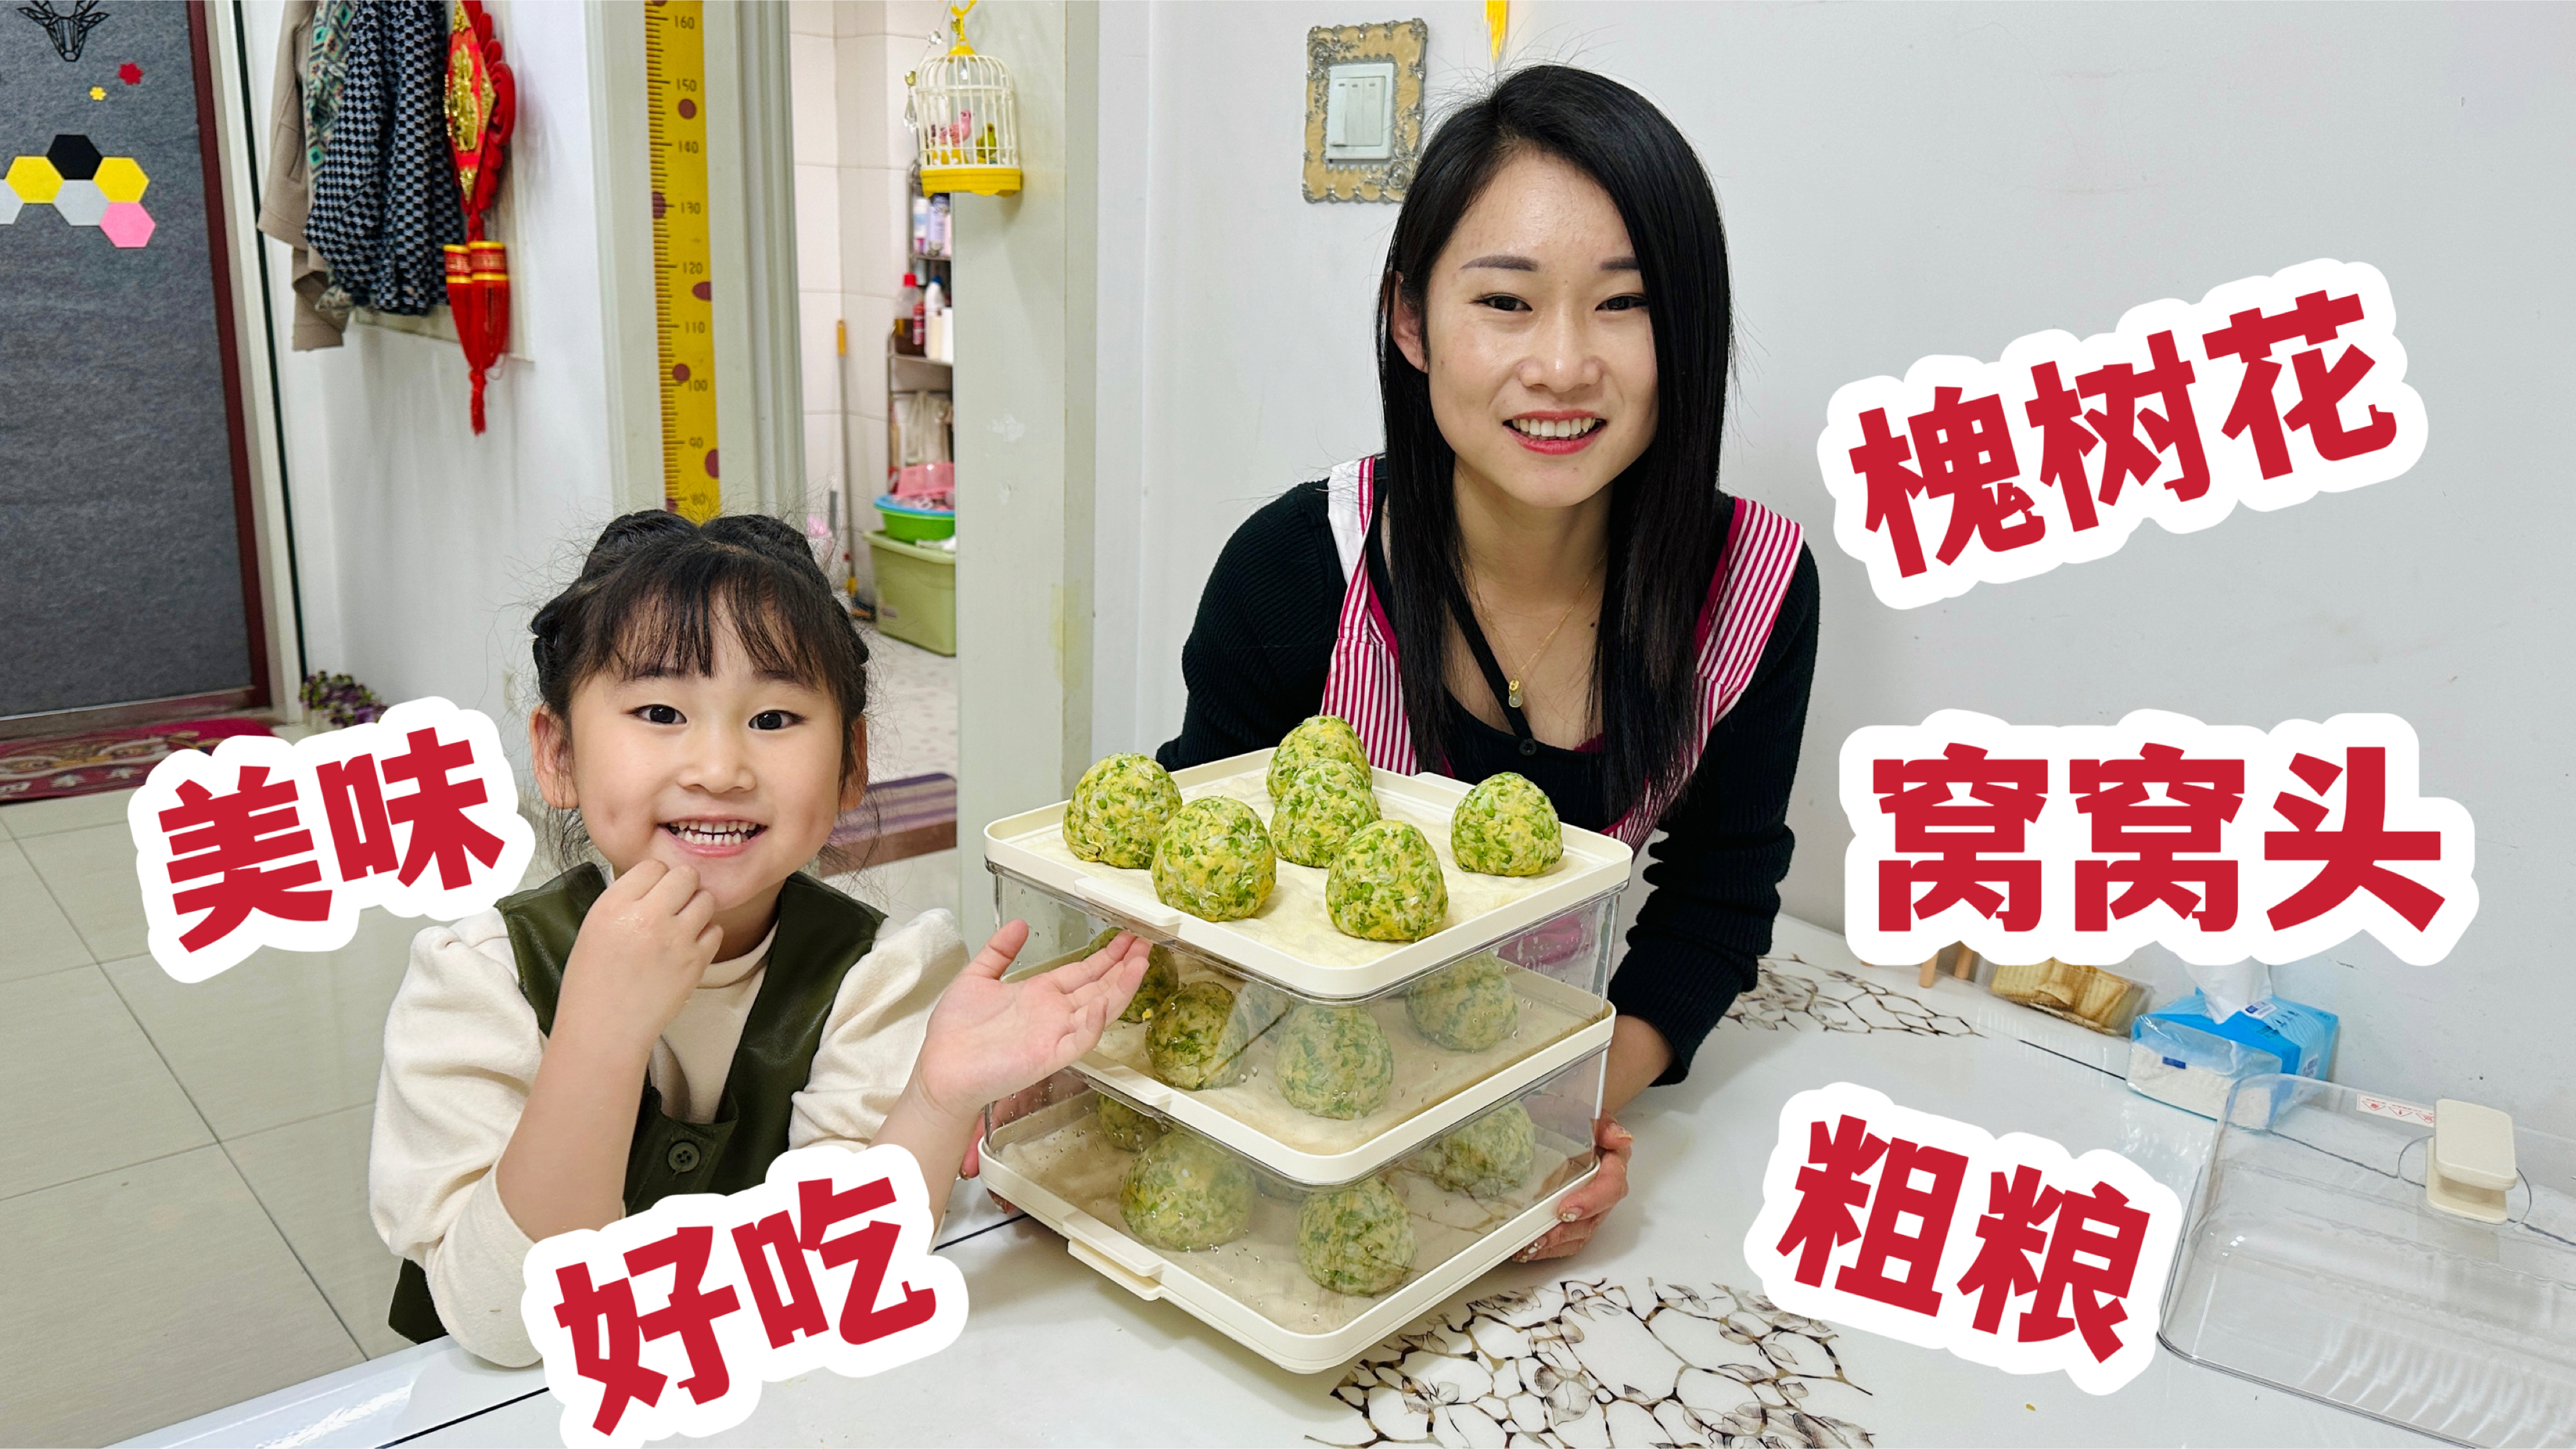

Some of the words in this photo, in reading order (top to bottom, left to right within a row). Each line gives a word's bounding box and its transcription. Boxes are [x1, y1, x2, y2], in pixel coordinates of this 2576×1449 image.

[675, 15, 694, 29] 160
[677, 79, 697, 91] 150
[678, 141, 698, 153] 140
[680, 202, 701, 214] 130
[683, 262, 703, 274] 120
[686, 322, 705, 334] 110
[688, 380, 708, 392] 100
[689, 437, 703, 448] 90
